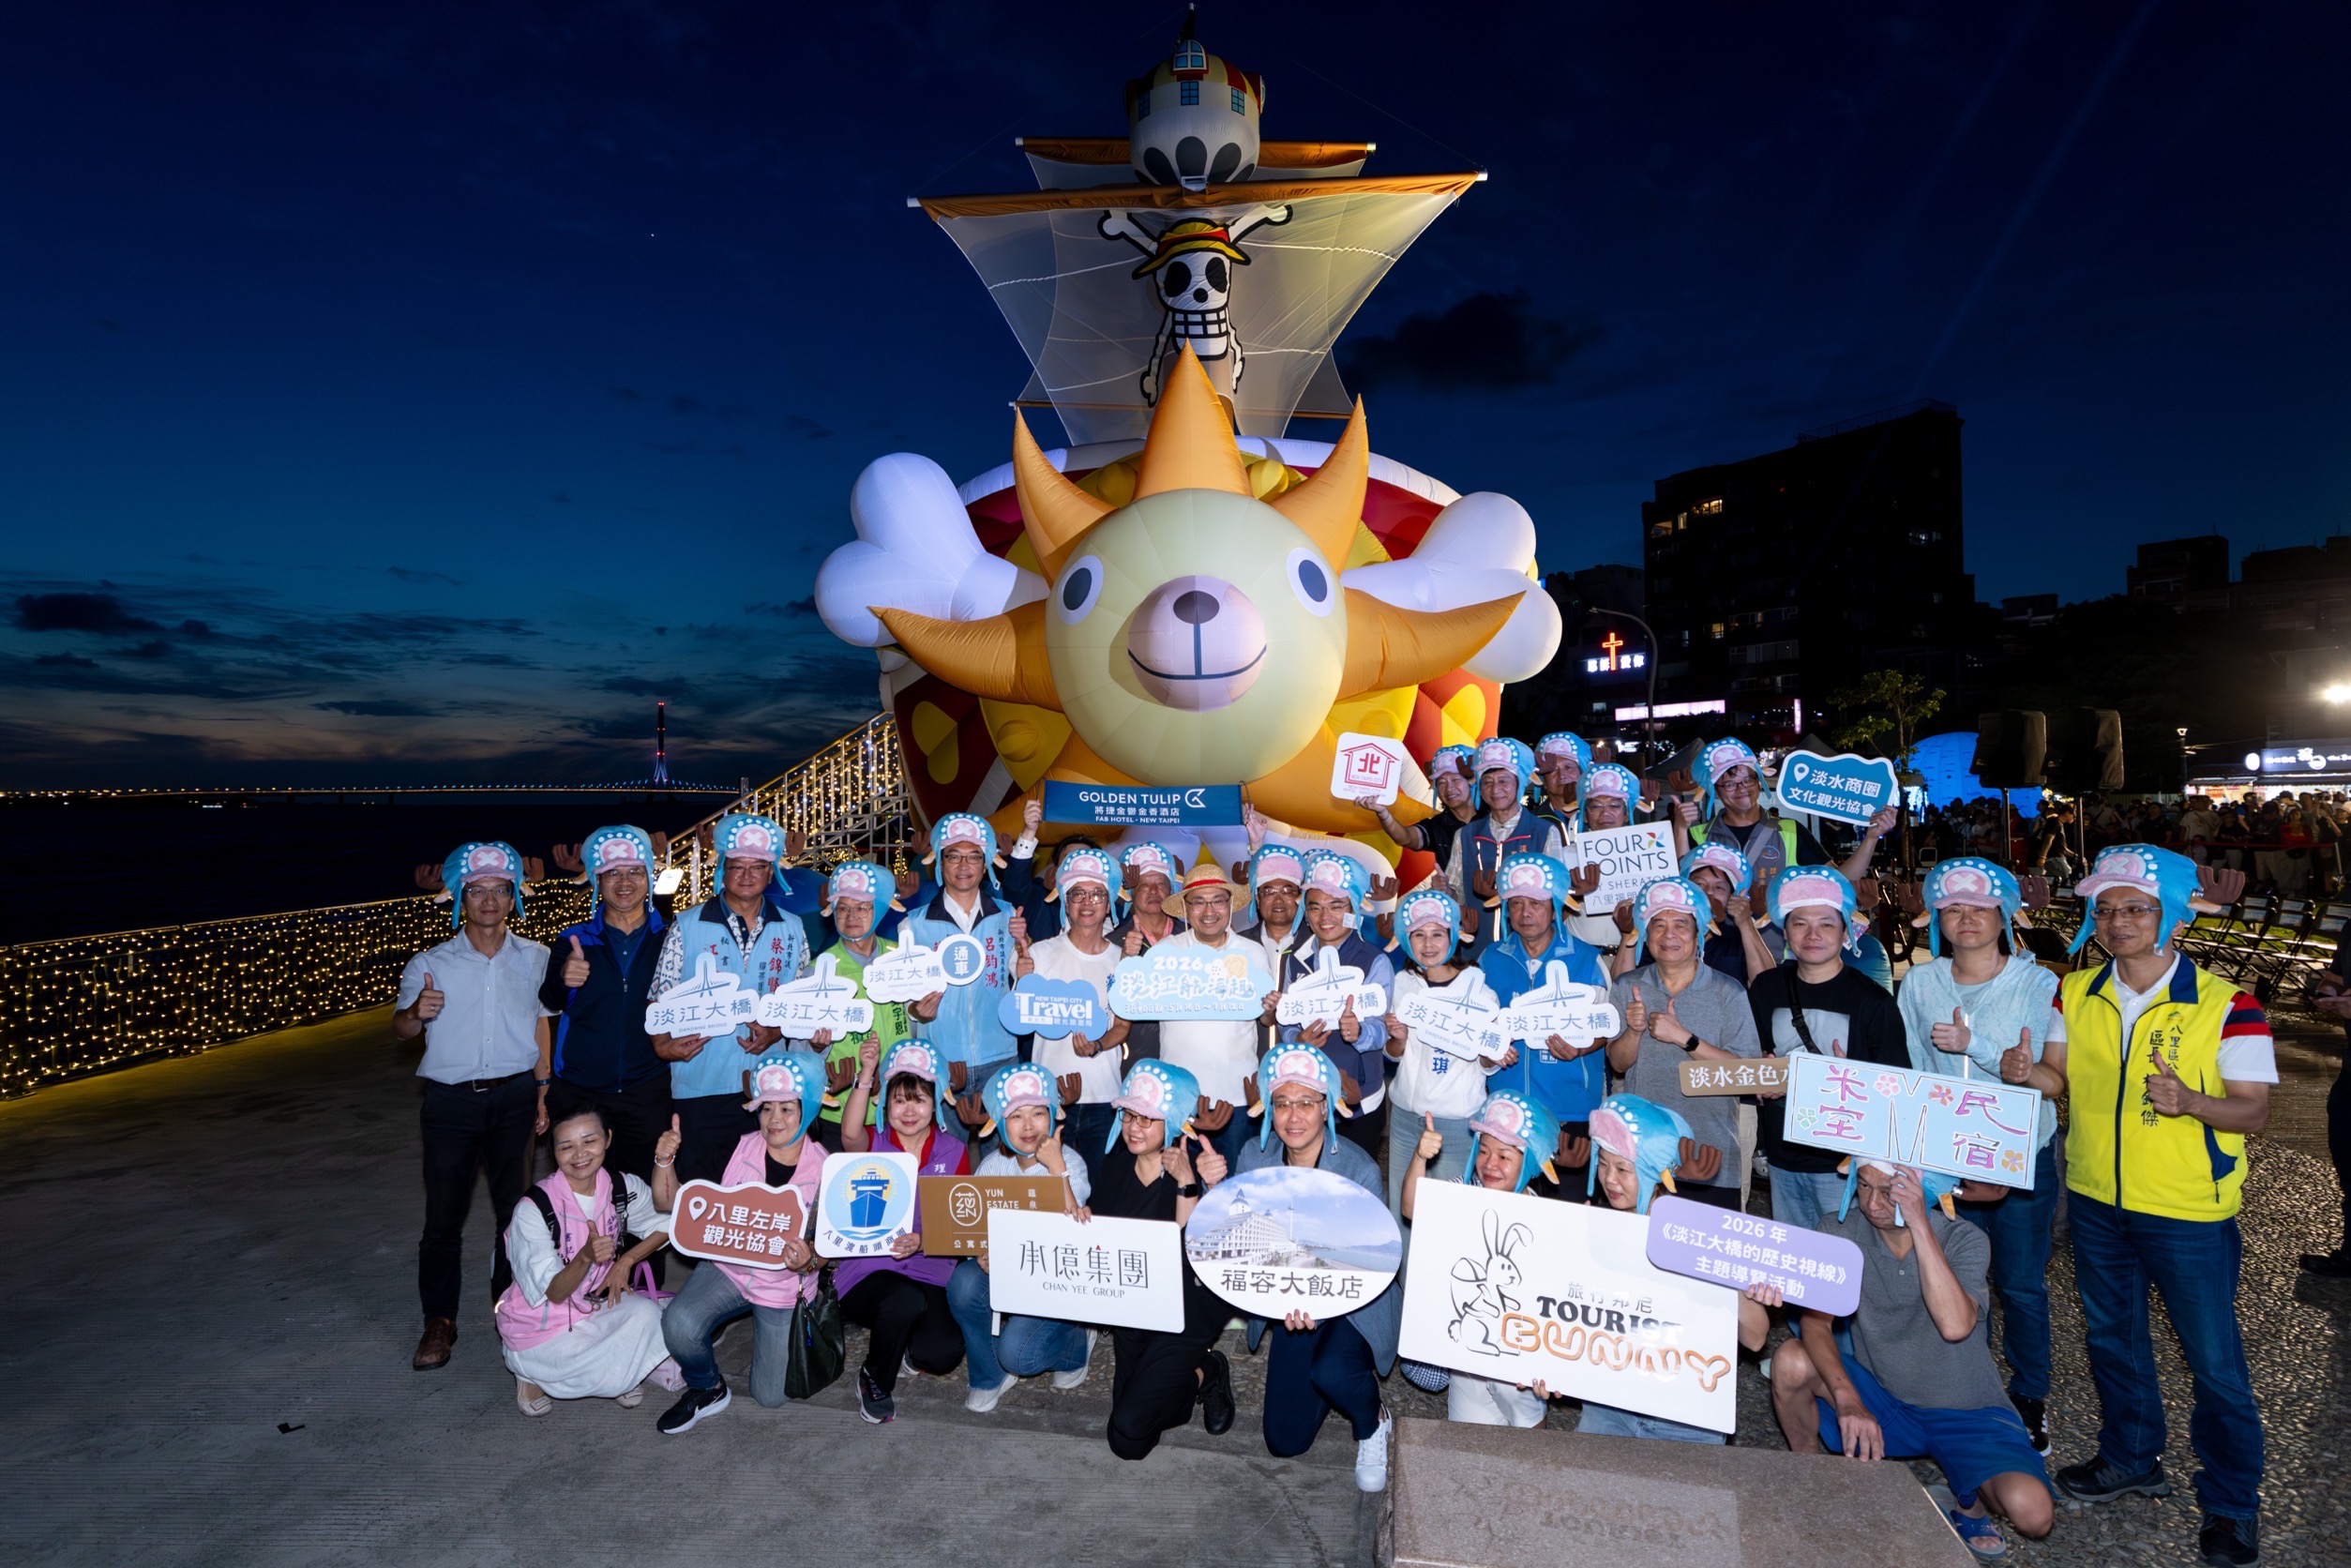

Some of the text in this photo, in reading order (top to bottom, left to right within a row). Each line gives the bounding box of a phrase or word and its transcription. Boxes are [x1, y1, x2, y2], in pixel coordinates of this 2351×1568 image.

[1358, 753, 1380, 775] 北
[1810, 769, 1881, 798] 淡水商圈
[1078, 791, 1181, 805] GOLDEN TULIP
[1094, 806, 1180, 817] 將捷金鬱金香酒店
[1787, 787, 1876, 817] 文化觀光協會
[1584, 834, 1644, 858] FOUR
[1587, 852, 1669, 876] OINTS
[869, 964, 942, 983] 淡江大橋
[954, 946, 970, 975] 通車
[1153, 956, 1204, 971] 2026
[1120, 970, 1257, 1002] 淡江航海趣
[653, 1000, 751, 1027] 淡江大橋
[764, 1002, 865, 1024] 淡江大橋
[1015, 992, 1093, 1019] Travel
[1284, 992, 1379, 1018] 淡江大橋
[1405, 1001, 1500, 1051] 淡江大橋
[1506, 1012, 1611, 1032] 淡江大橋
[1424, 1030, 1471, 1051] DANJIANG BRIDGE
[2147, 1030, 2164, 1063] 區長
[985, 1188, 1003, 1198] YUN
[987, 1200, 1019, 1210] ESTATE
[707, 1202, 791, 1233] 八里左岸
[1721, 1214, 1788, 1244] 2026 年
[702, 1224, 787, 1257] 觀光協會
[1662, 1222, 1847, 1285] 《淡江大橋的歷史視線》
[1019, 1240, 1149, 1289] 承億集團
[1695, 1256, 1806, 1300] 主題導覽活動
[1043, 1281, 1125, 1298] CHAN YEE GROUP
[1221, 1270, 1364, 1299] 福容大飯店
[1536, 1295, 1684, 1346] TOURIST
[1500, 1312, 1731, 1393] BUNNY
